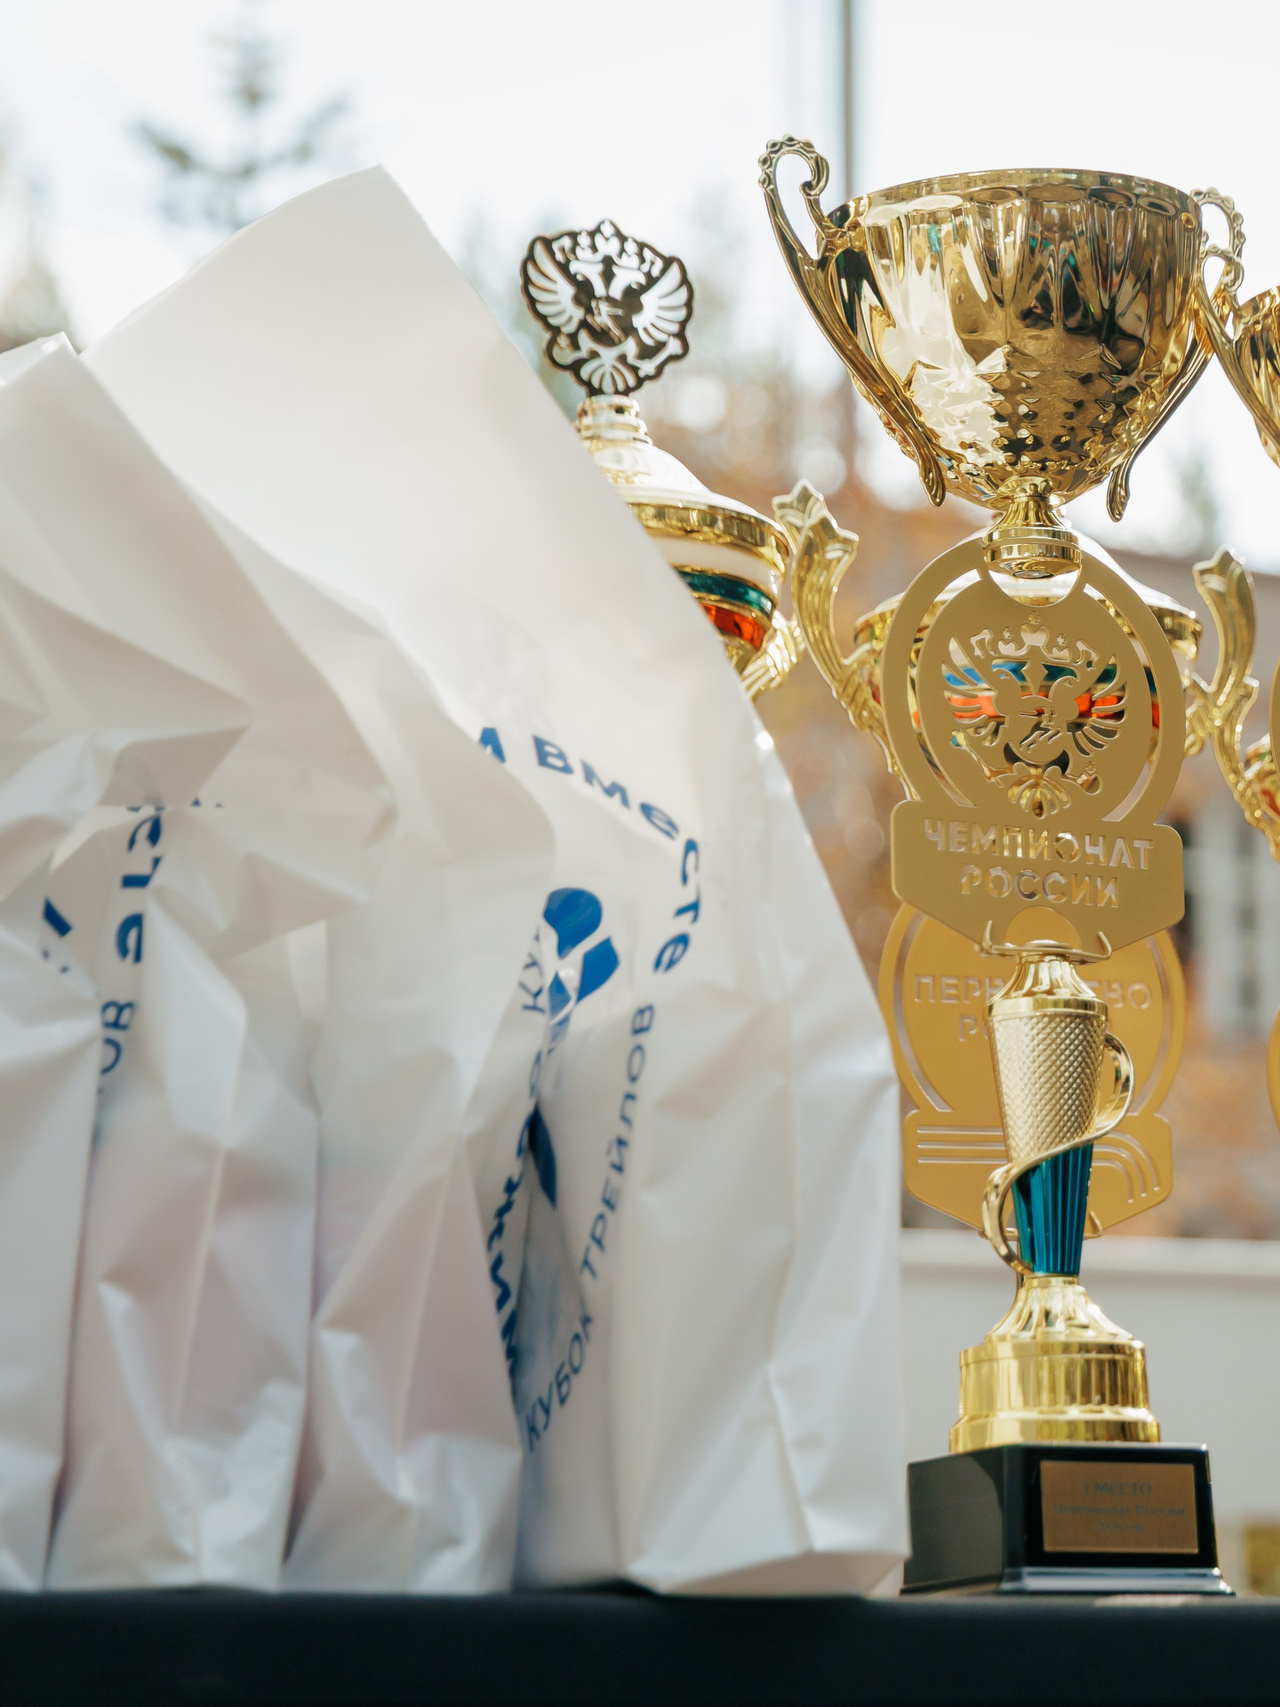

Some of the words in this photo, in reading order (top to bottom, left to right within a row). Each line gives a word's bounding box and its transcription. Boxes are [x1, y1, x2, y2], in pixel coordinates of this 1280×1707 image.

[922, 818, 1155, 871] ЧЕМПИОНАТ
[960, 863, 1120, 909] РОССИИ
[580, 1003, 655, 1280] ТРЕЙЛОВ
